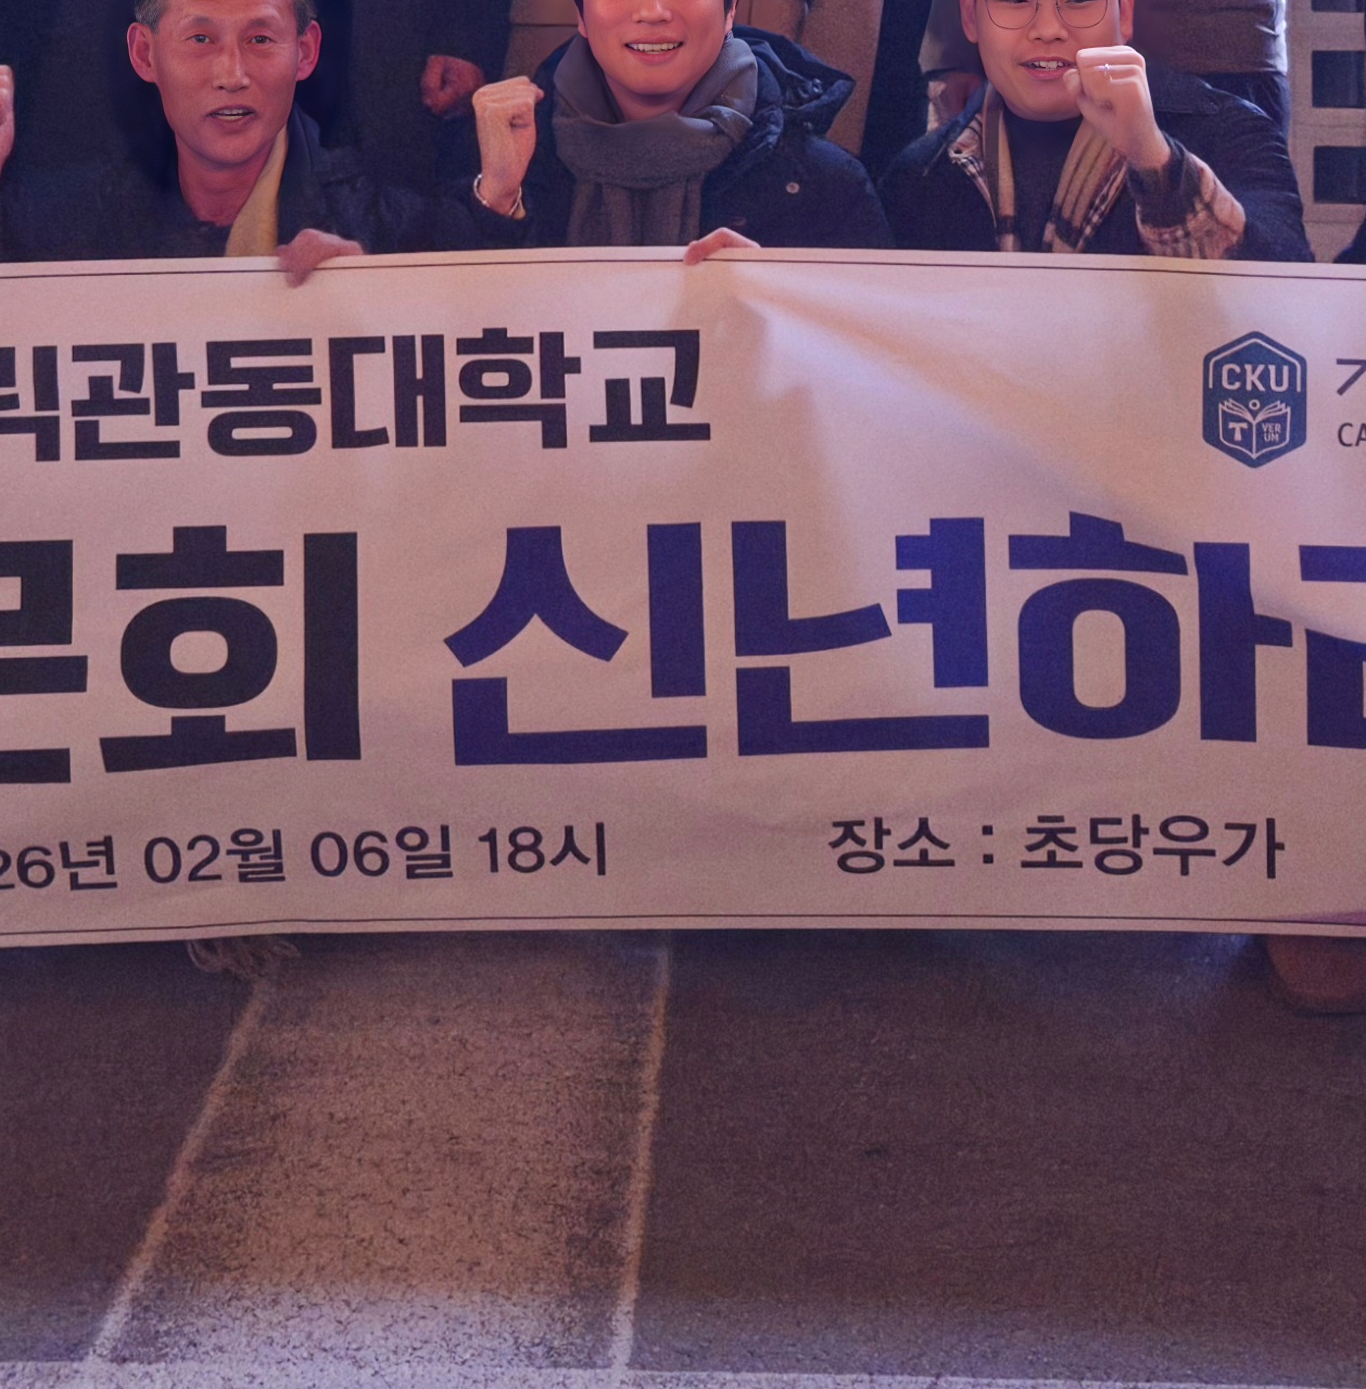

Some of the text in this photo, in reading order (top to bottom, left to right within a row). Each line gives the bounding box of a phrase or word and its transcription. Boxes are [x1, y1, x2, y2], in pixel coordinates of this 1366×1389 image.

[1221, 363, 1290, 392] CKU
[142, 827, 287, 884] 02월
[308, 823, 454, 880] 06일
[477, 822, 608, 878] 18시
[828, 814, 1285, 879] 장소 : 초당우가
